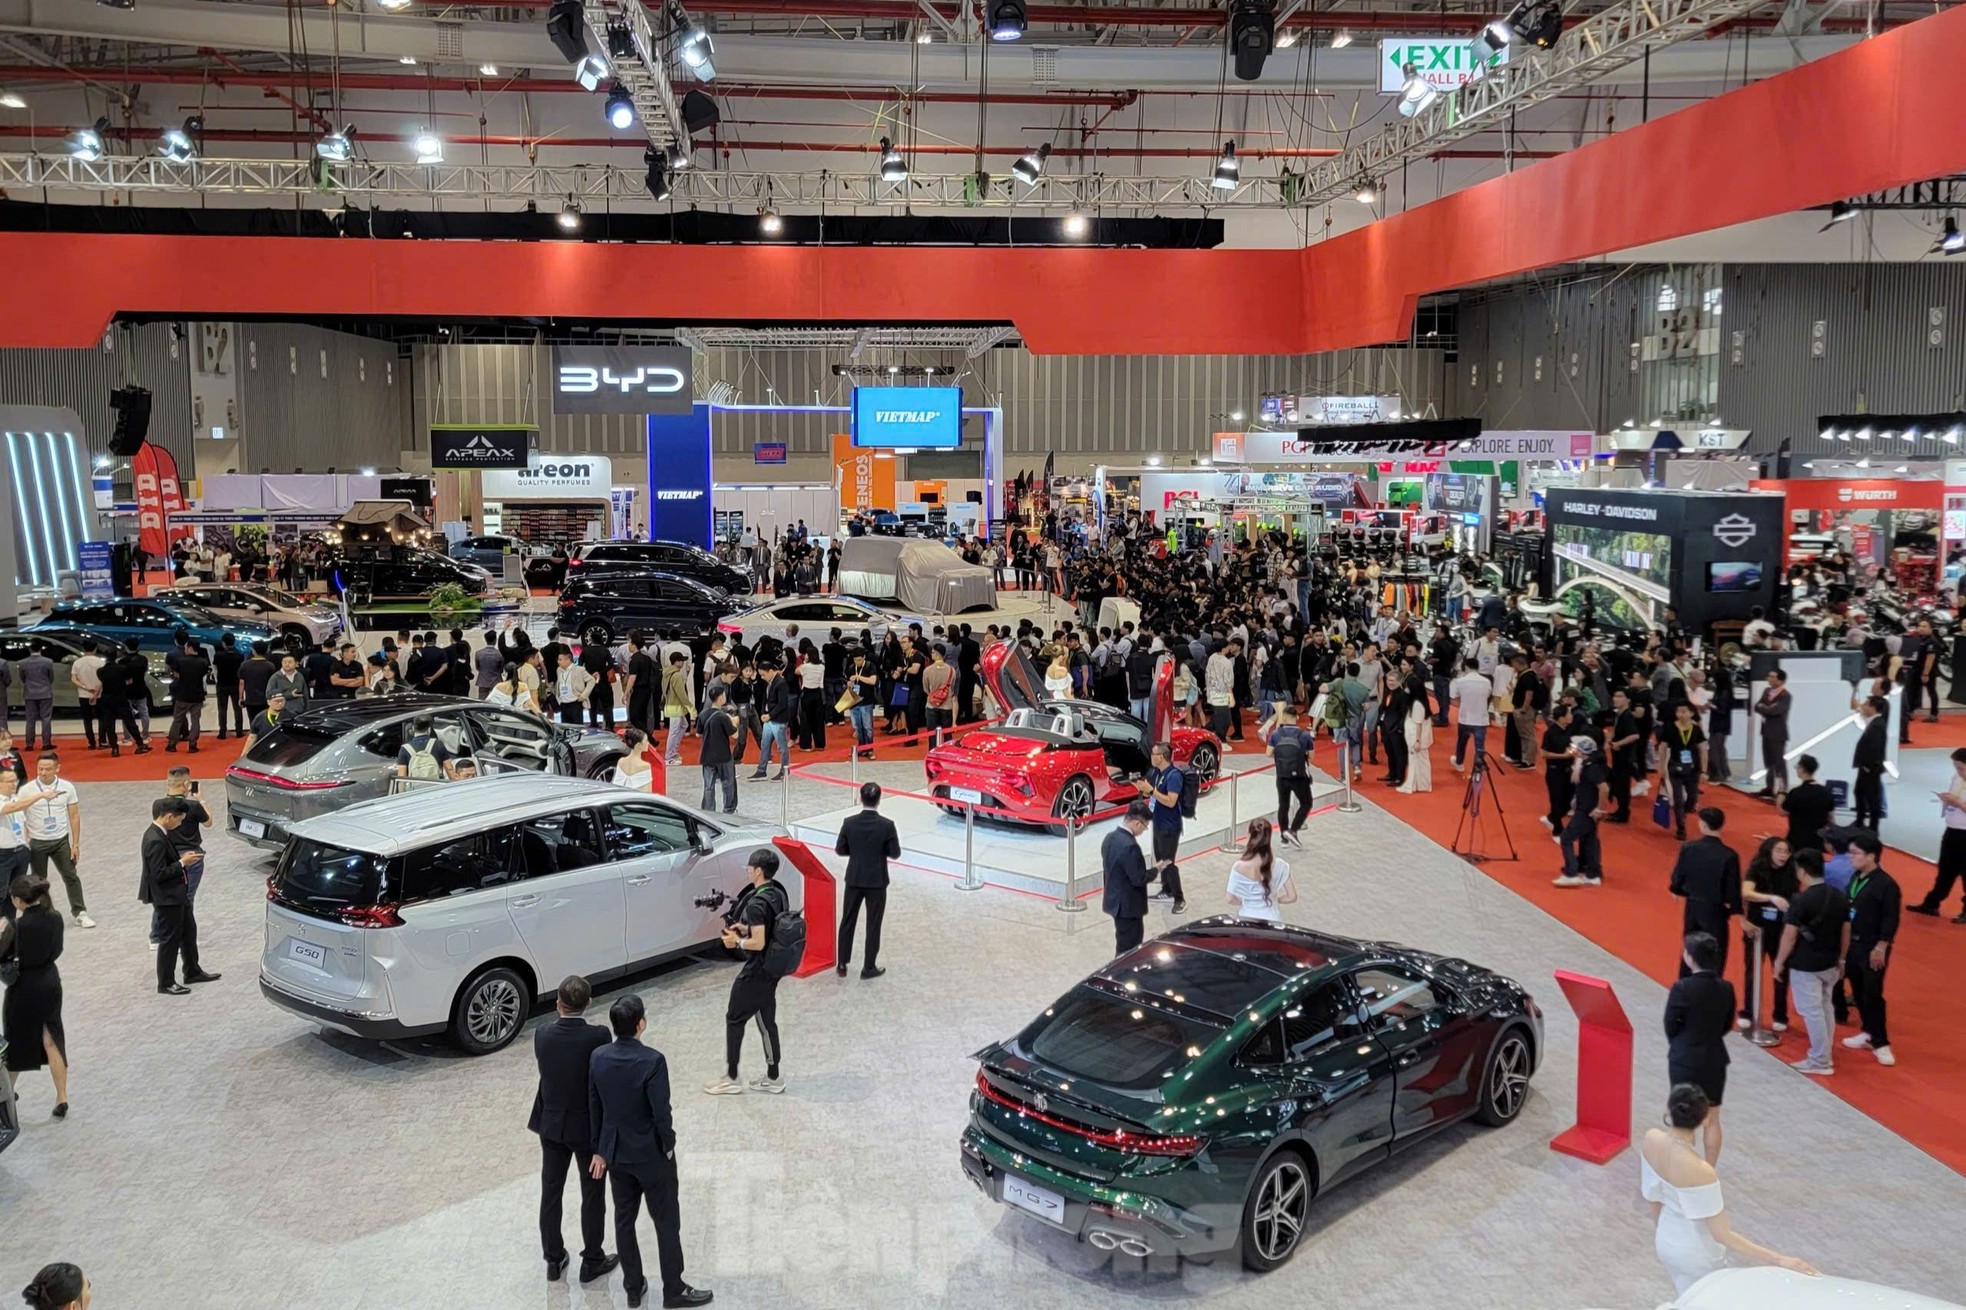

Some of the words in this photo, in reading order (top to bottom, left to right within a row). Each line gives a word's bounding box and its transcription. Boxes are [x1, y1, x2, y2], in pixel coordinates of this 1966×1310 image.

[1407, 45, 1479, 70] EXIT
[1422, 73, 1454, 85] ALL
[1656, 307, 1699, 361] B2
[560, 367, 685, 393] BYD
[875, 411, 935, 423] VIETMAP
[1518, 439, 1554, 454] ENJOY.
[1699, 433, 1725, 446] KST
[518, 464, 590, 478] areon
[855, 455, 869, 506] ENEOS
[1316, 484, 1343, 492] AUDIO
[657, 491, 700, 500] VIETMAP
[1563, 501, 1657, 521] HARLEY-DAVIDSON
[295, 945, 320, 960] G50
